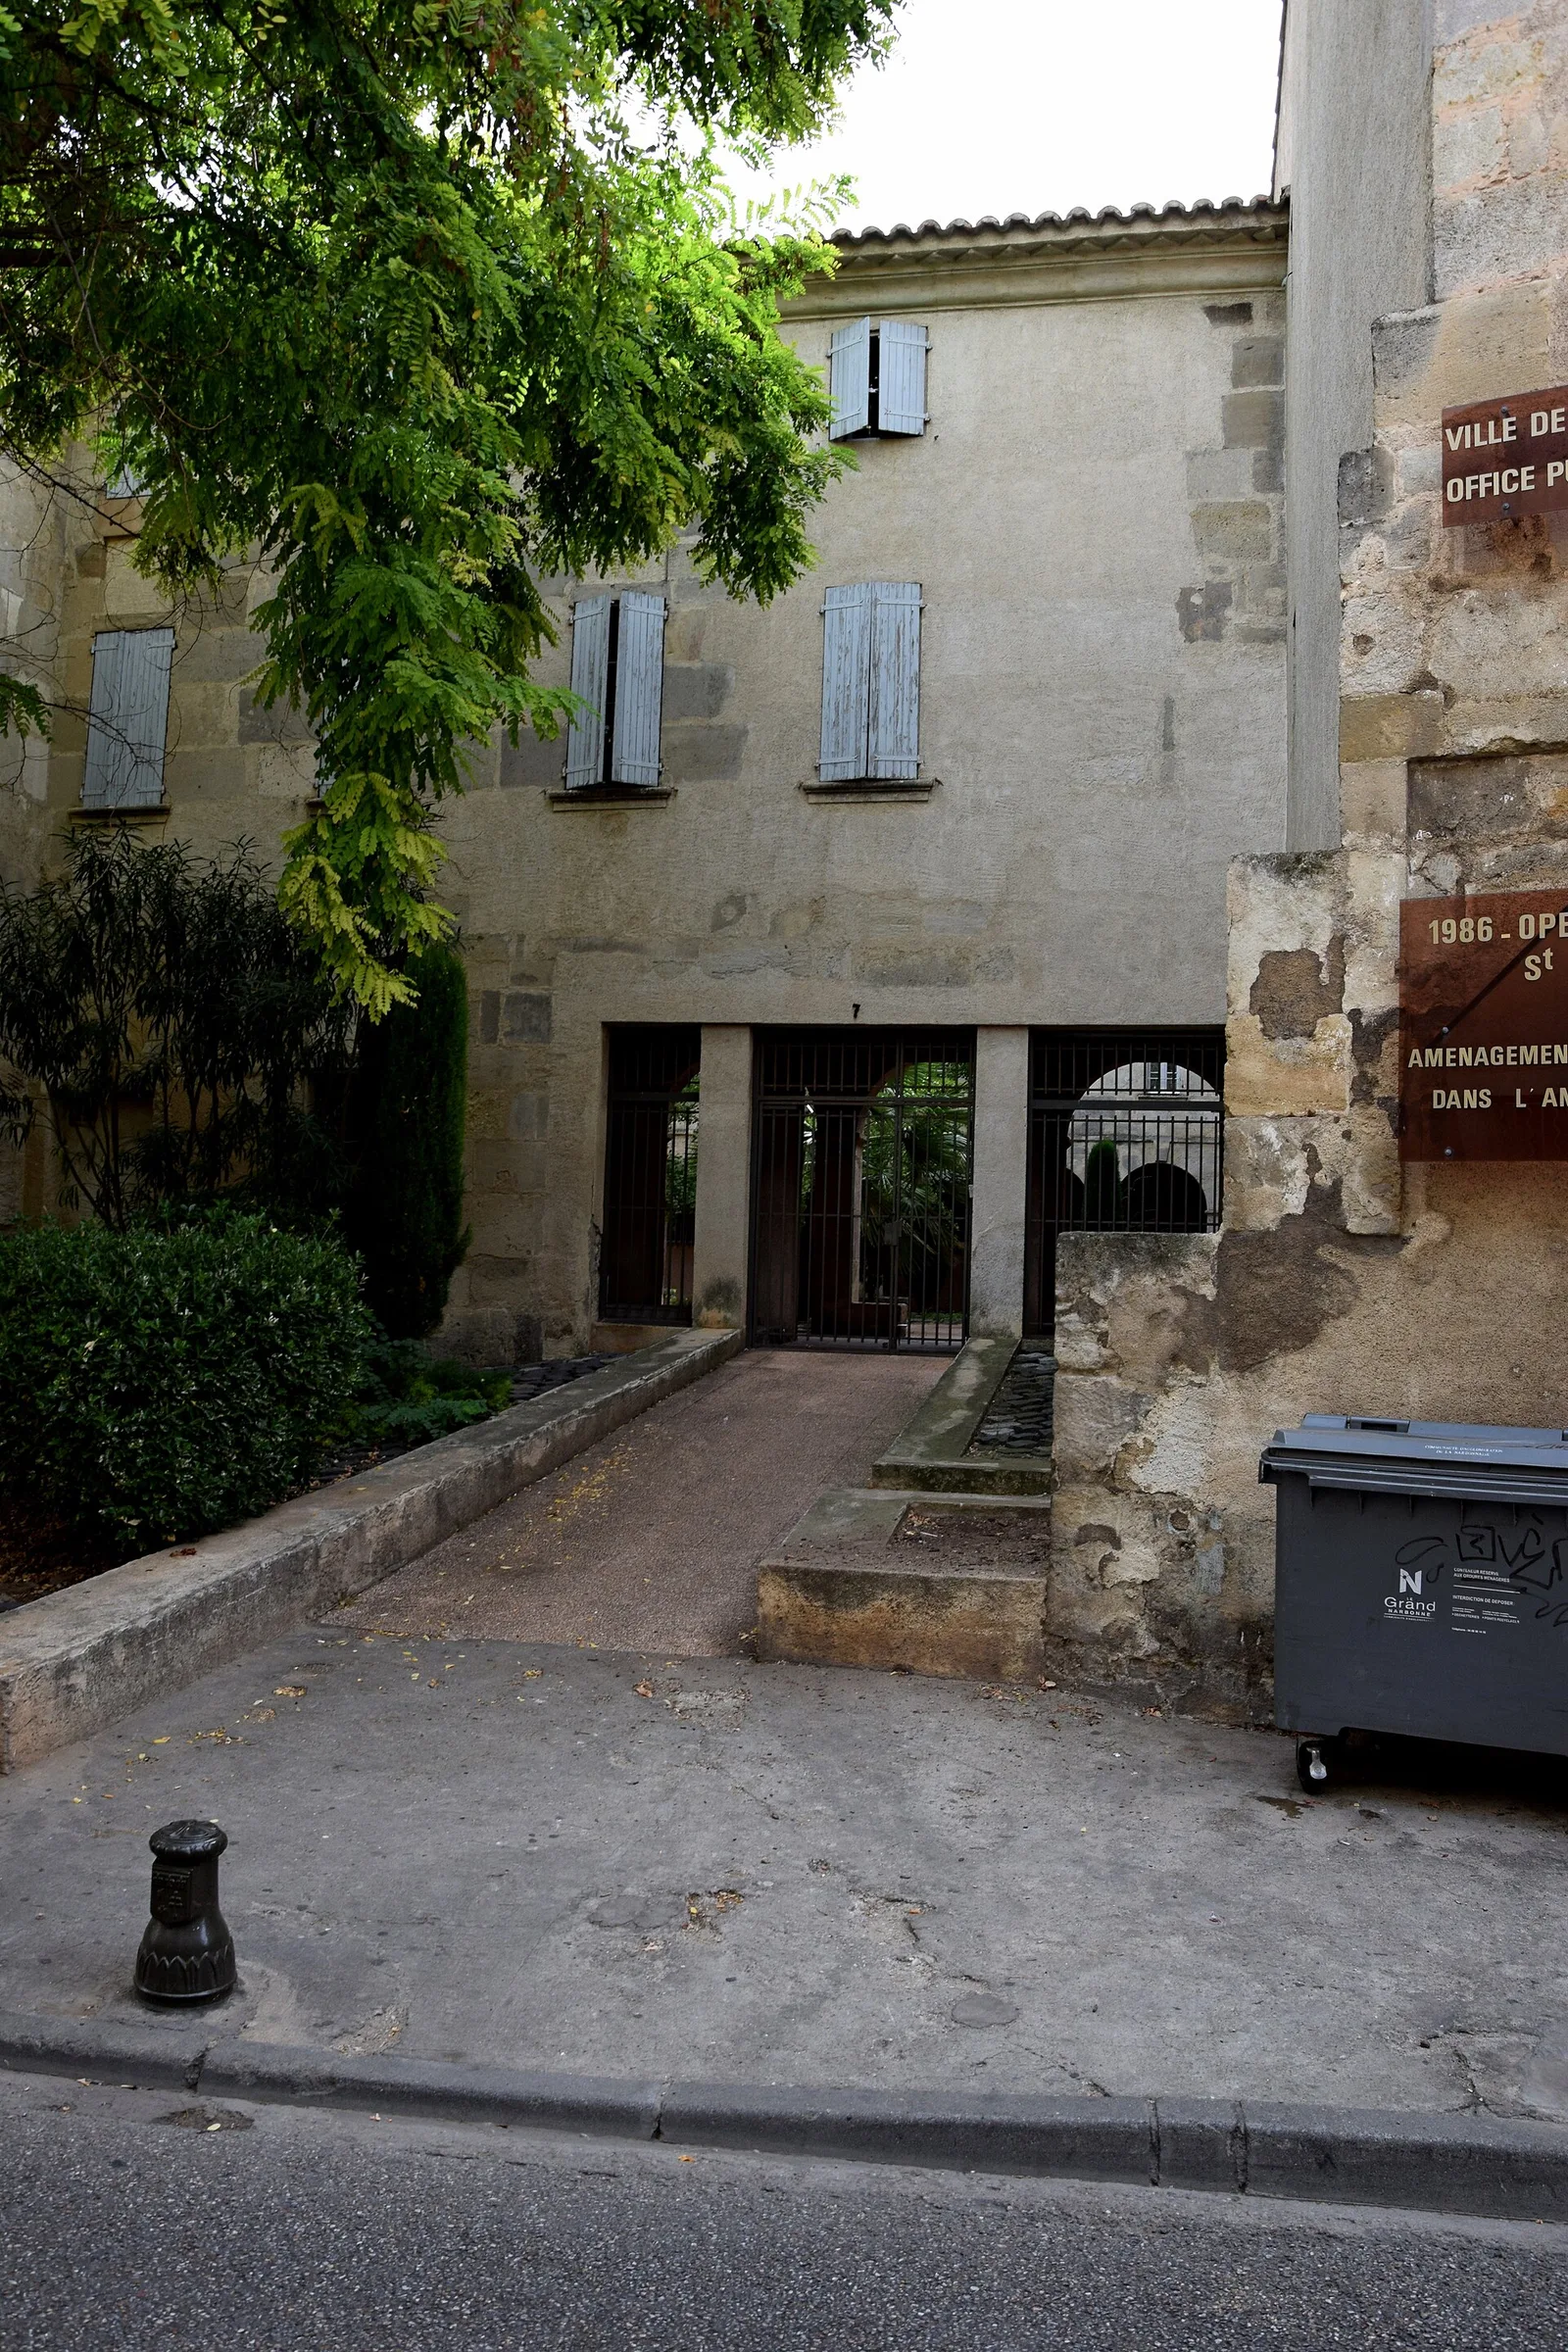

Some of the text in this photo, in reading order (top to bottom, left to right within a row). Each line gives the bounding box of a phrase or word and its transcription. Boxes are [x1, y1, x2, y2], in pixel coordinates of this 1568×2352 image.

[1446, 408, 1566, 452] VILLE DE
[1446, 459, 1568, 503] OFFICE P
[1524, 947, 1554, 981] St
[852, 1003, 861, 1019] 7
[1407, 1044, 1568, 1068] AMENAGEMEN
[1432, 1089, 1493, 1109] DANS
[1398, 1568, 1422, 1595] N
[1384, 1596, 1436, 1612] Grand
[1451, 1594, 1484, 1603] INTERDICTION
[1388, 1608, 1431, 1617] NARBONNE
